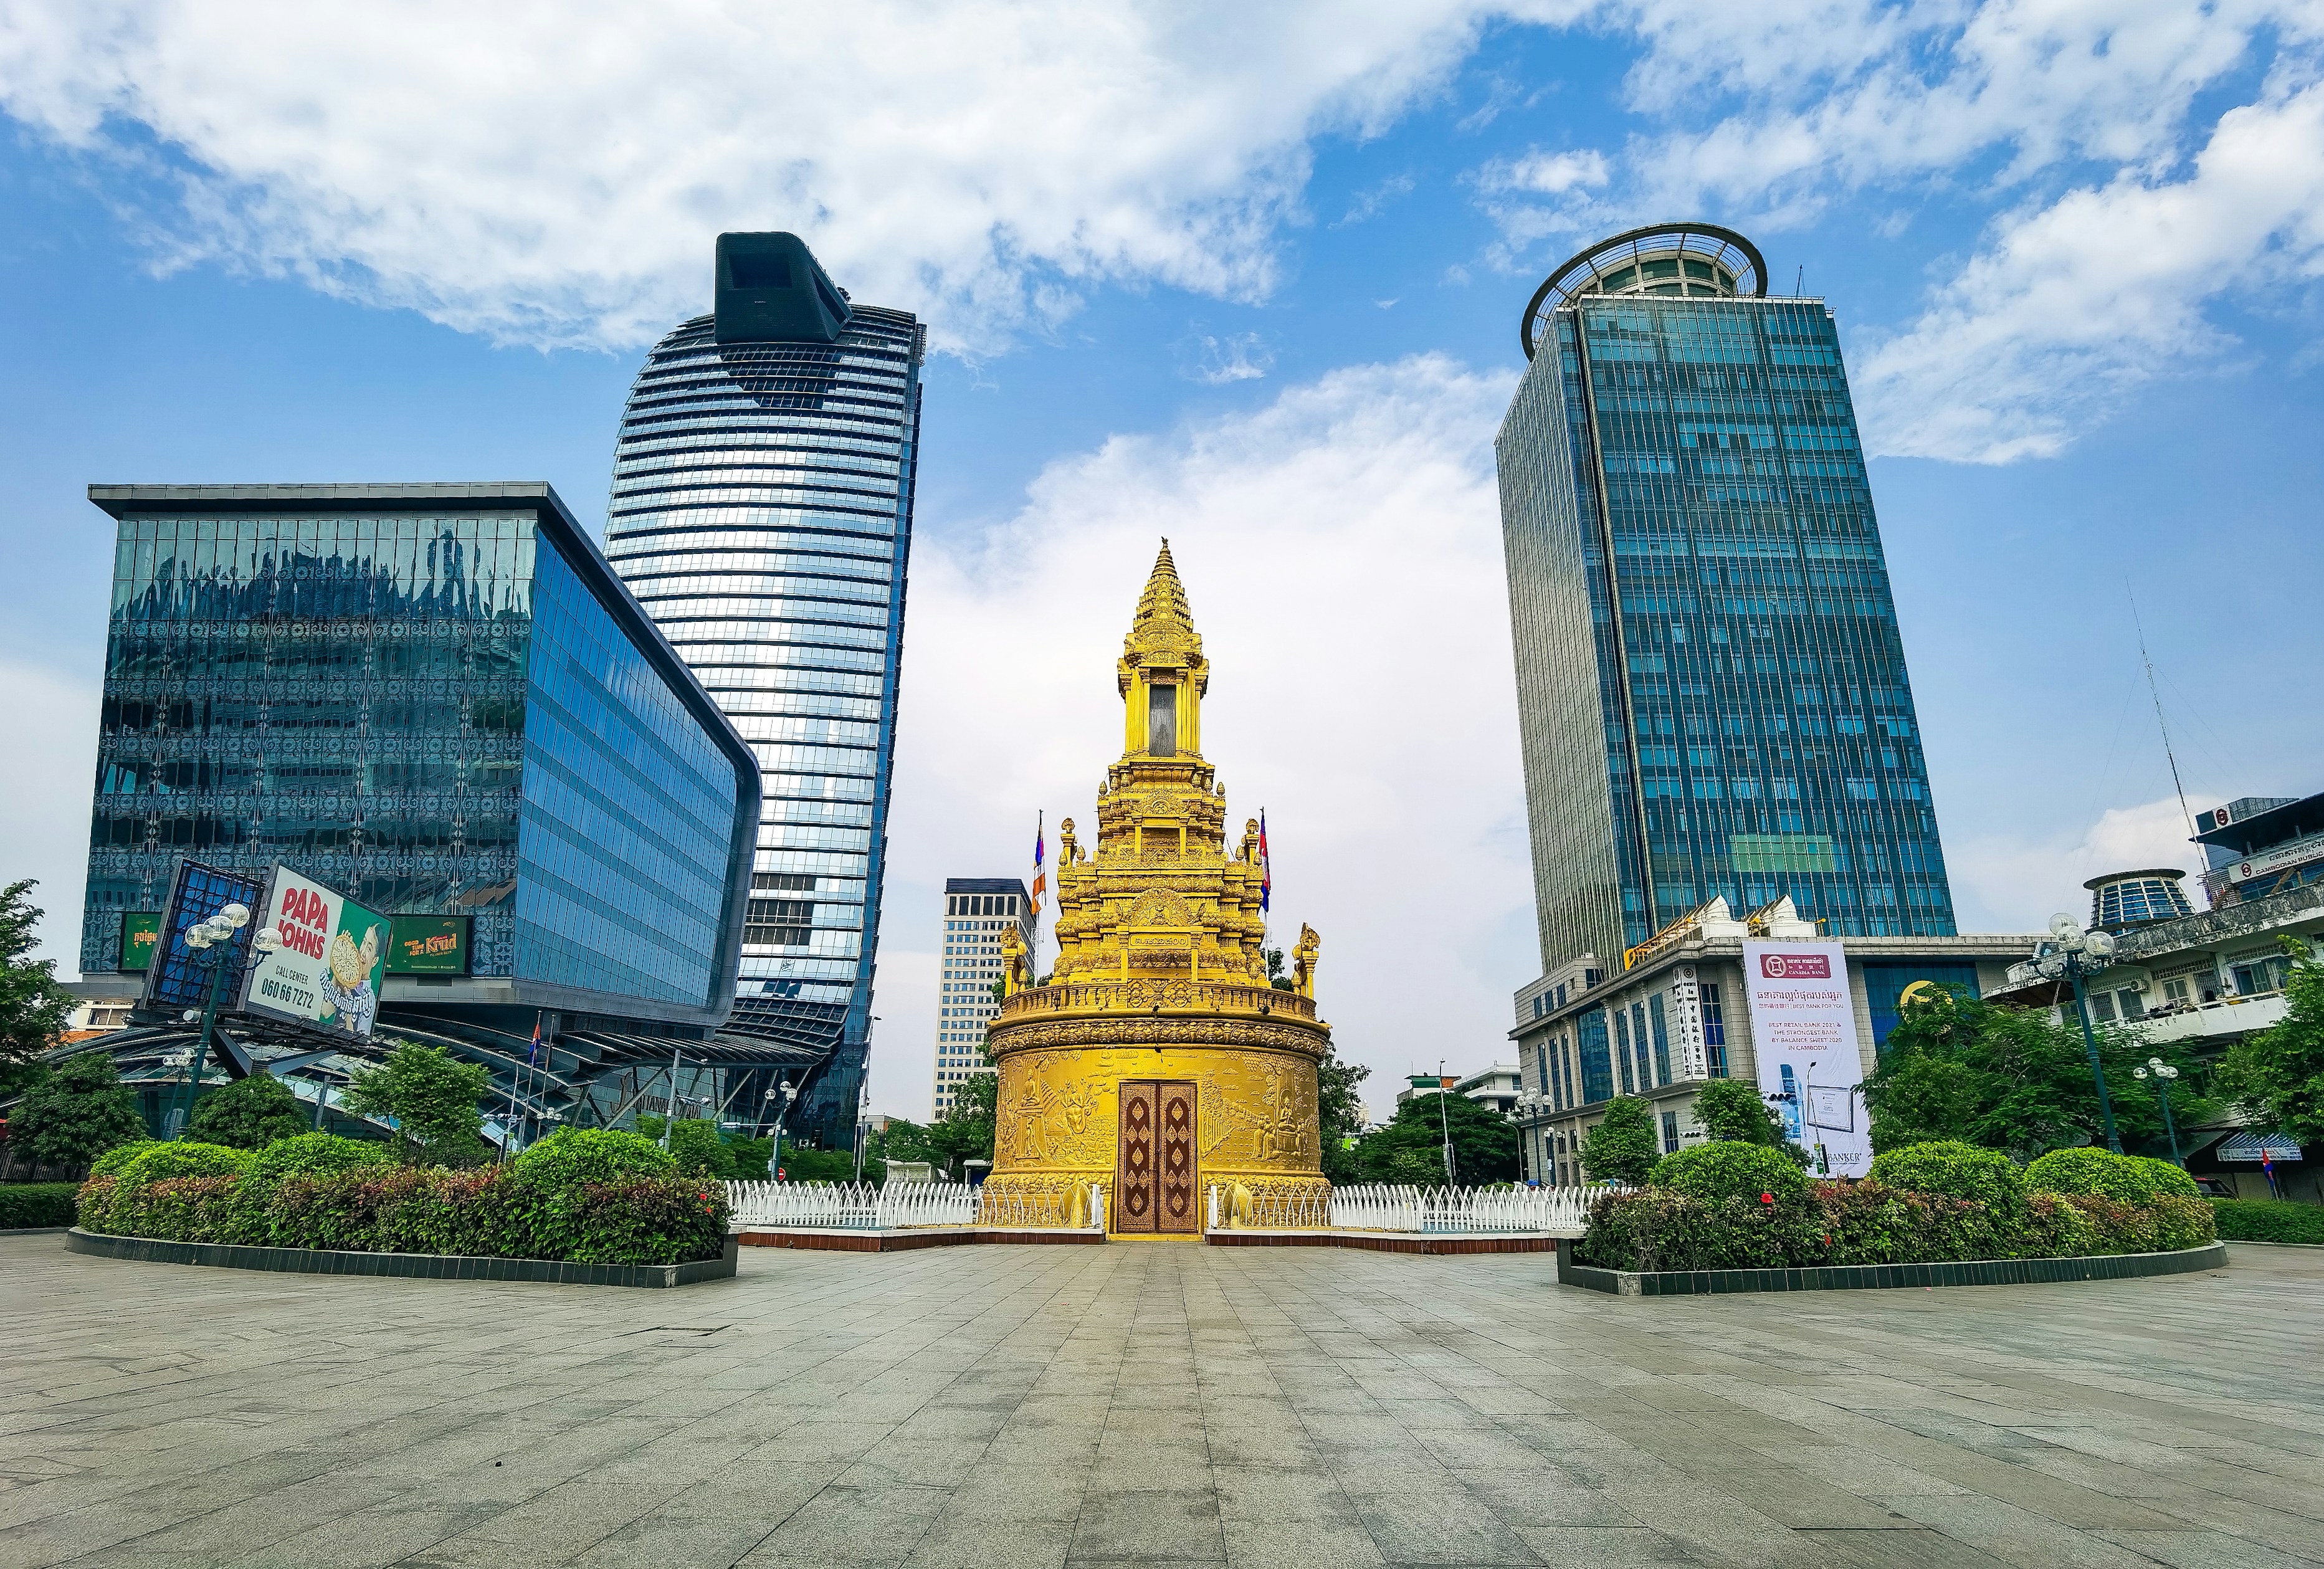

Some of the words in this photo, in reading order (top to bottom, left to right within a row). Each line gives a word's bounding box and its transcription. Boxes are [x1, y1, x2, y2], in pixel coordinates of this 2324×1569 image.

[2255, 859, 2297, 874] CAMBODIAN
[2298, 851, 2323, 862] PUBLIC
[281, 888, 328, 934] PAPA
[278, 919, 326, 960] JOHNS
[426, 933, 457, 954] Krud
[275, 965, 289, 980] CALL
[288, 970, 309, 985] CENTER
[261, 978, 280, 998] 060
[280, 983, 293, 1003] 66
[293, 986, 315, 1009] 7272
[1828, 1153, 1860, 1161] BANKER
